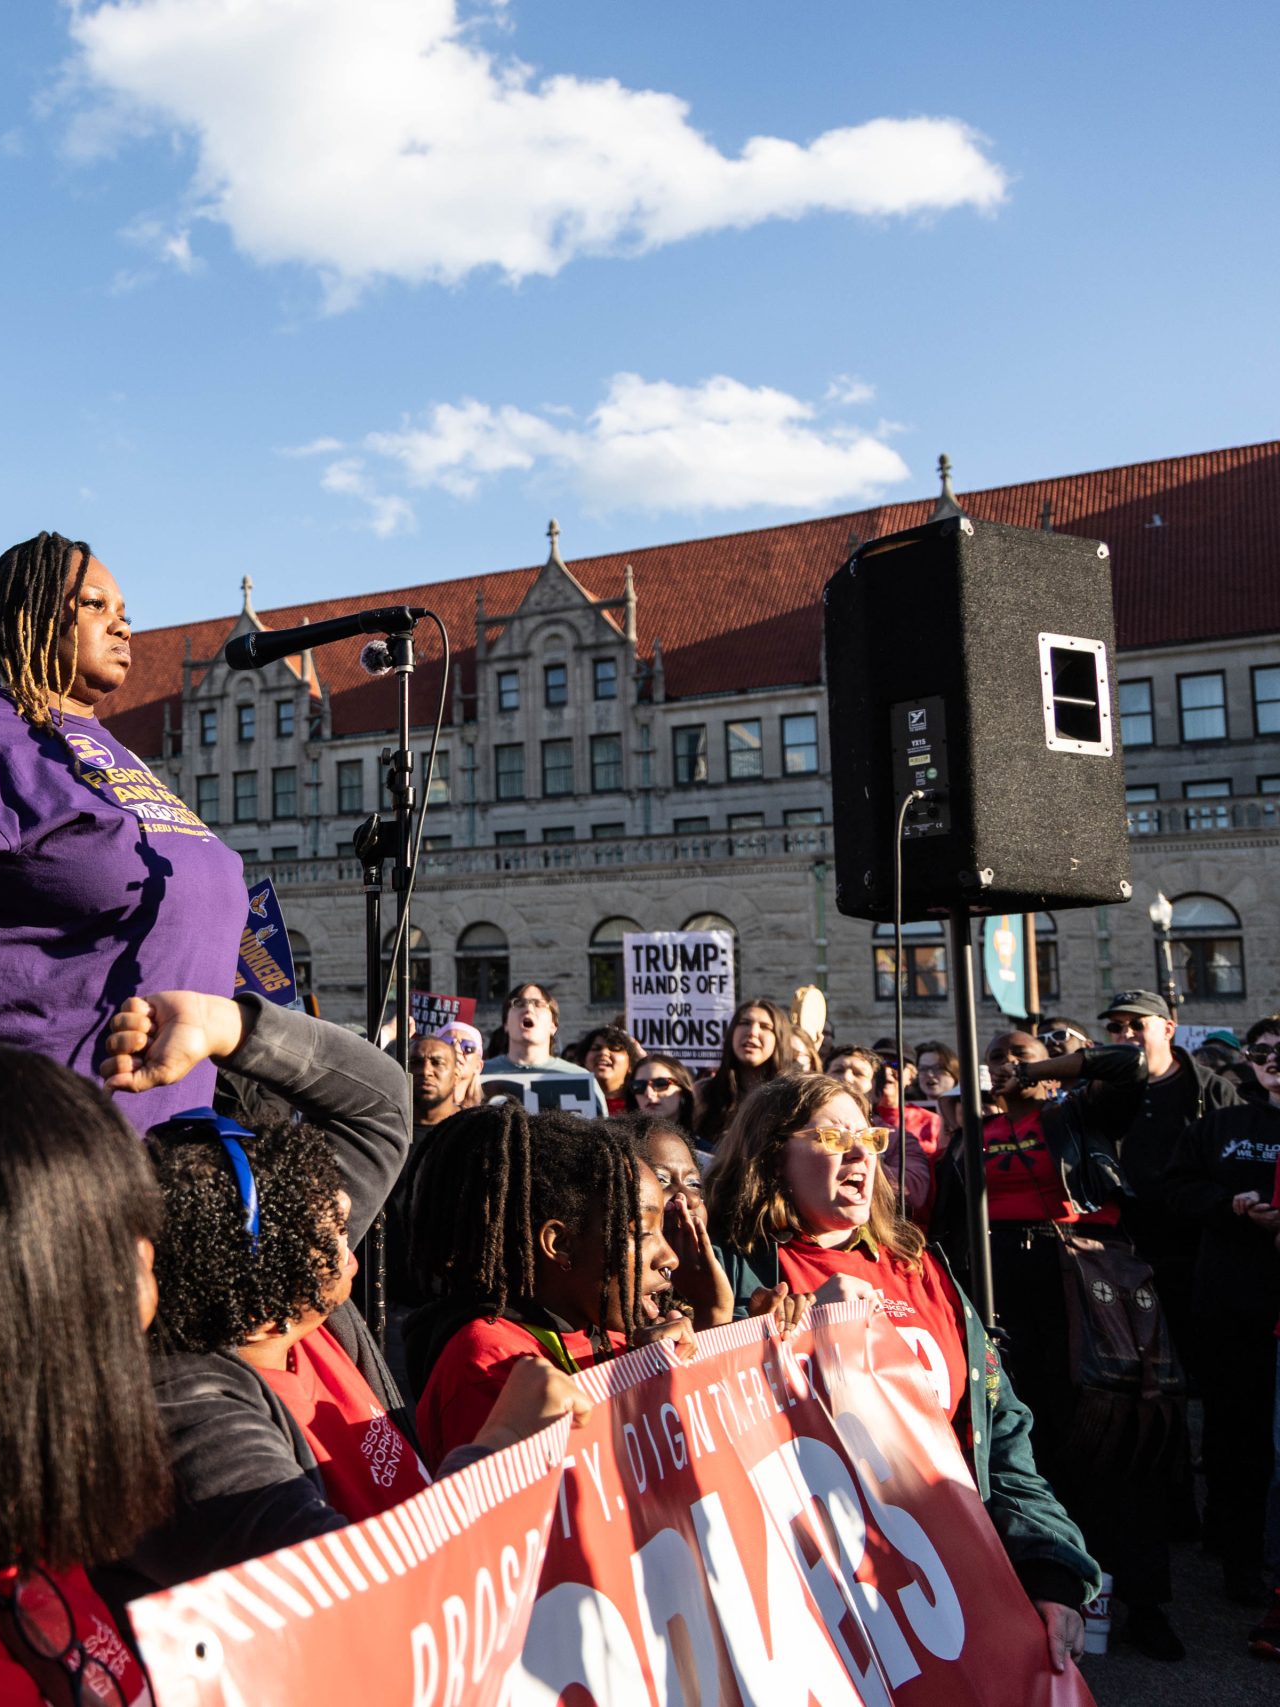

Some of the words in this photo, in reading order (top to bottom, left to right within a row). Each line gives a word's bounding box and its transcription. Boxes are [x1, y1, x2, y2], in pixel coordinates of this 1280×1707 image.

[81, 767, 151, 789] FIGHT
[113, 785, 162, 802] AND
[632, 943, 727, 973] TRUMP:
[632, 975, 691, 995] HANDS
[696, 974, 728, 994] OFF
[412, 993, 429, 1008] WE
[435, 998, 460, 1013] ARE
[666, 1003, 692, 1017] OUR
[413, 1007, 456, 1026] WORTH
